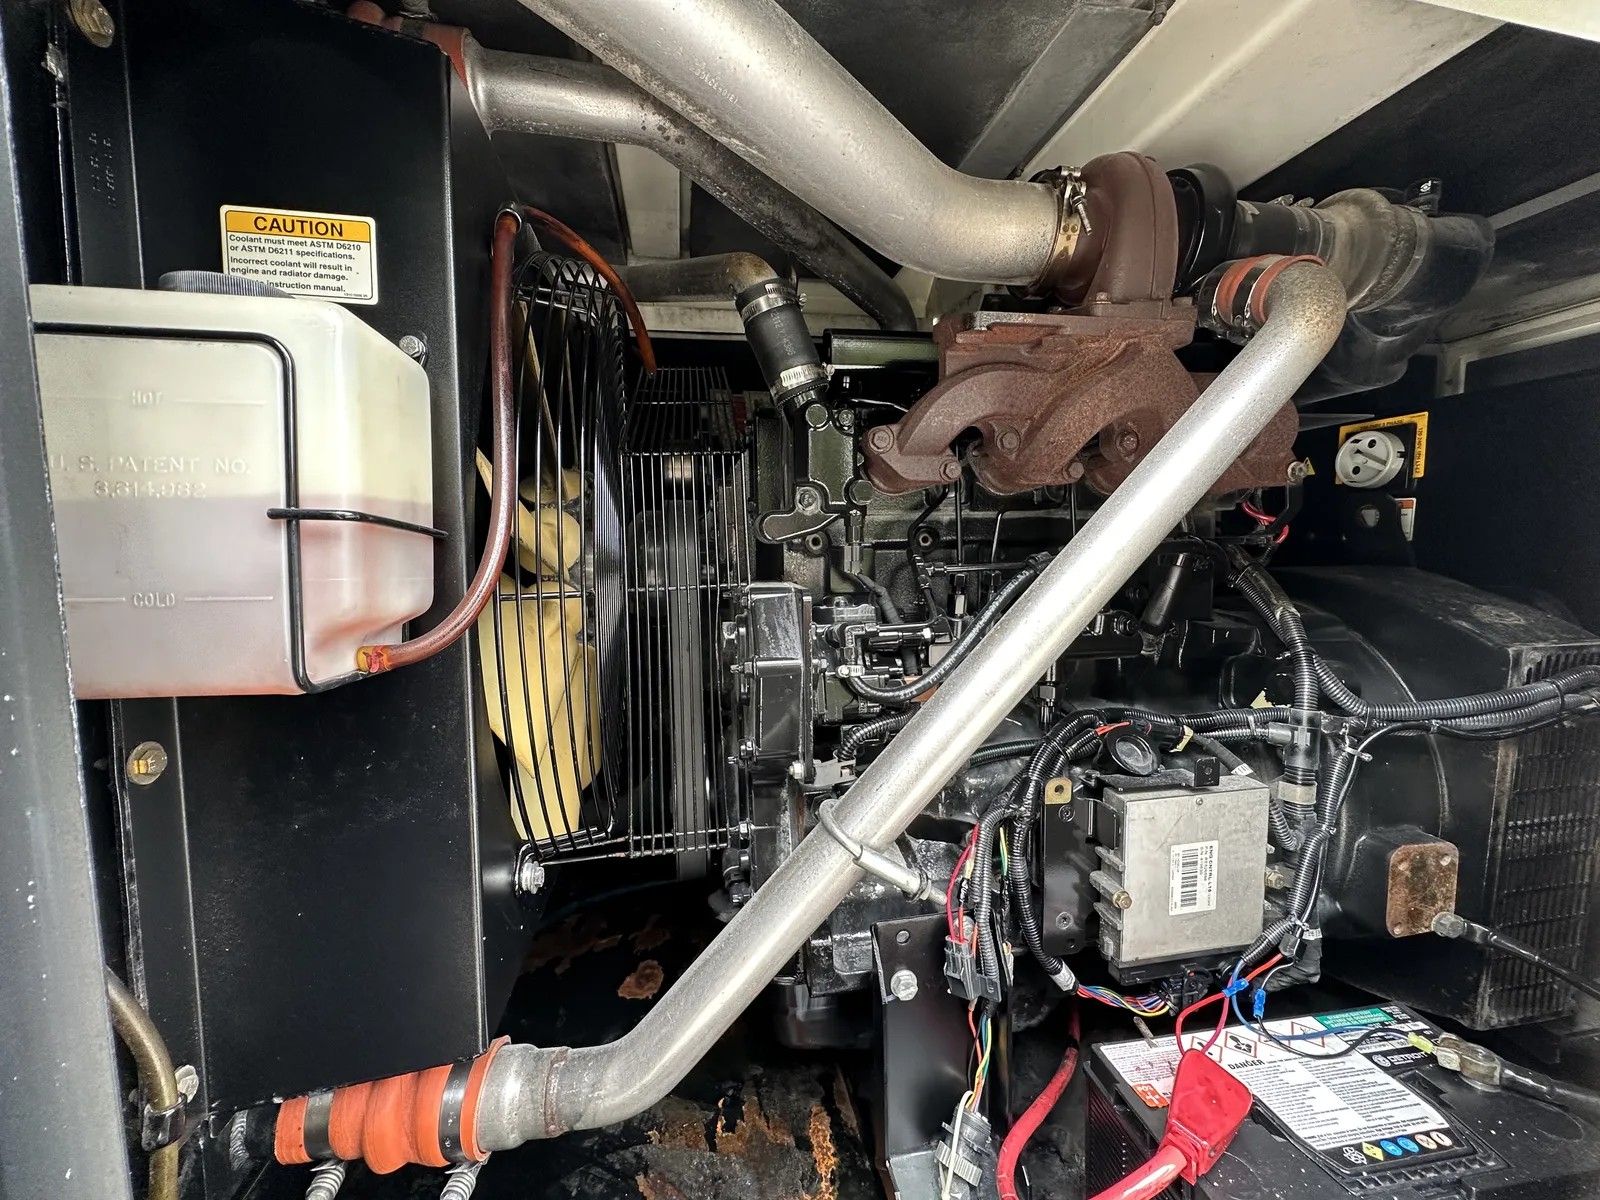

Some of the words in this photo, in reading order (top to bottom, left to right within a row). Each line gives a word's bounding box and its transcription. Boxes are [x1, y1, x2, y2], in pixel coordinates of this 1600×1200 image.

[254, 216, 343, 237] CAUTION
[229, 234, 262, 243] Coolant
[264, 238, 285, 246] must
[310, 240, 334, 249] ASTM
[336, 242, 361, 251] D6210
[241, 245, 266, 253] ASTM
[268, 247, 293, 255] D6211
[296, 248, 355, 260] specifications.
[230, 256, 268, 266] Incorrect
[270, 259, 301, 268] coolant
[319, 263, 343, 271] result
[231, 267, 259, 276] engine
[280, 270, 311, 278] radiator
[313, 272, 348, 282] damage.
[314, 284, 346, 292] manual.
[132, 390, 163, 406] HOT
[78, 455, 100, 472] S.
[110, 456, 200, 473] PATENT
[215, 458, 251, 474] NO.
[133, 592, 175, 607] COLD
[1228, 1060, 1265, 1070] DANGER
